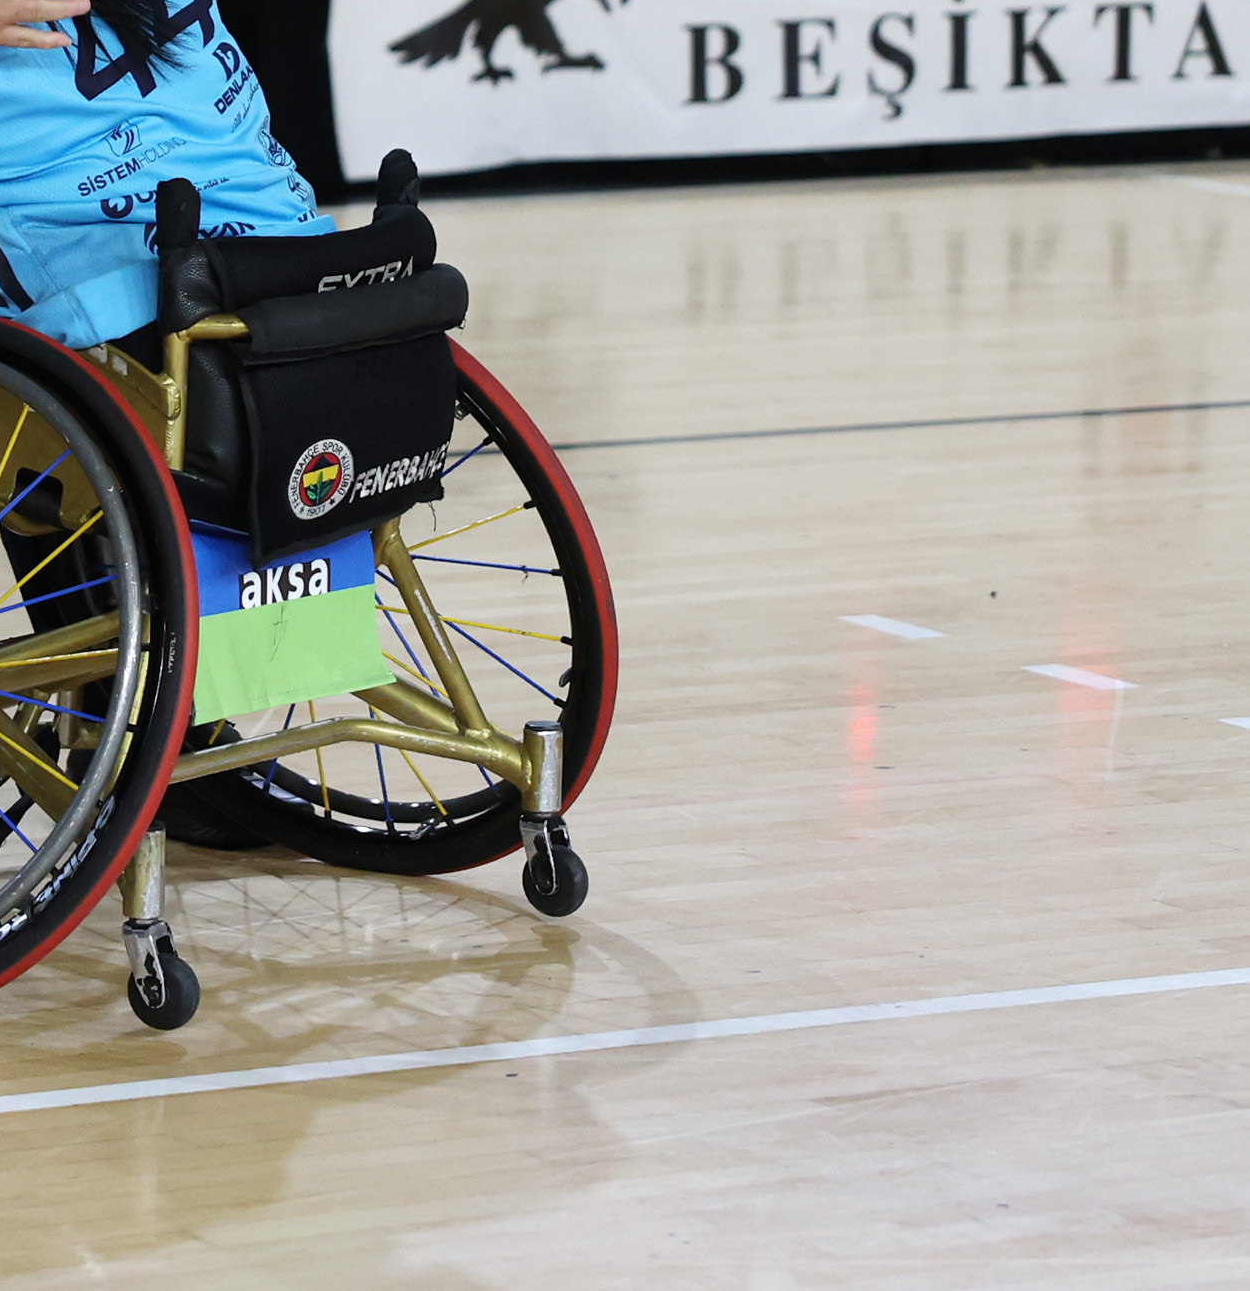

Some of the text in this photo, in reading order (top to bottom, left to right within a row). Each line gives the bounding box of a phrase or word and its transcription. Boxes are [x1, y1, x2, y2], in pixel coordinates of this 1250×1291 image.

[290, 443, 320, 509] FENERBAHÇE
[322, 441, 344, 456] SPOR
[349, 441, 450, 503] FENERBAHÇ
[306, 504, 327, 517] 1907
[241, 558, 329, 610] aksa
